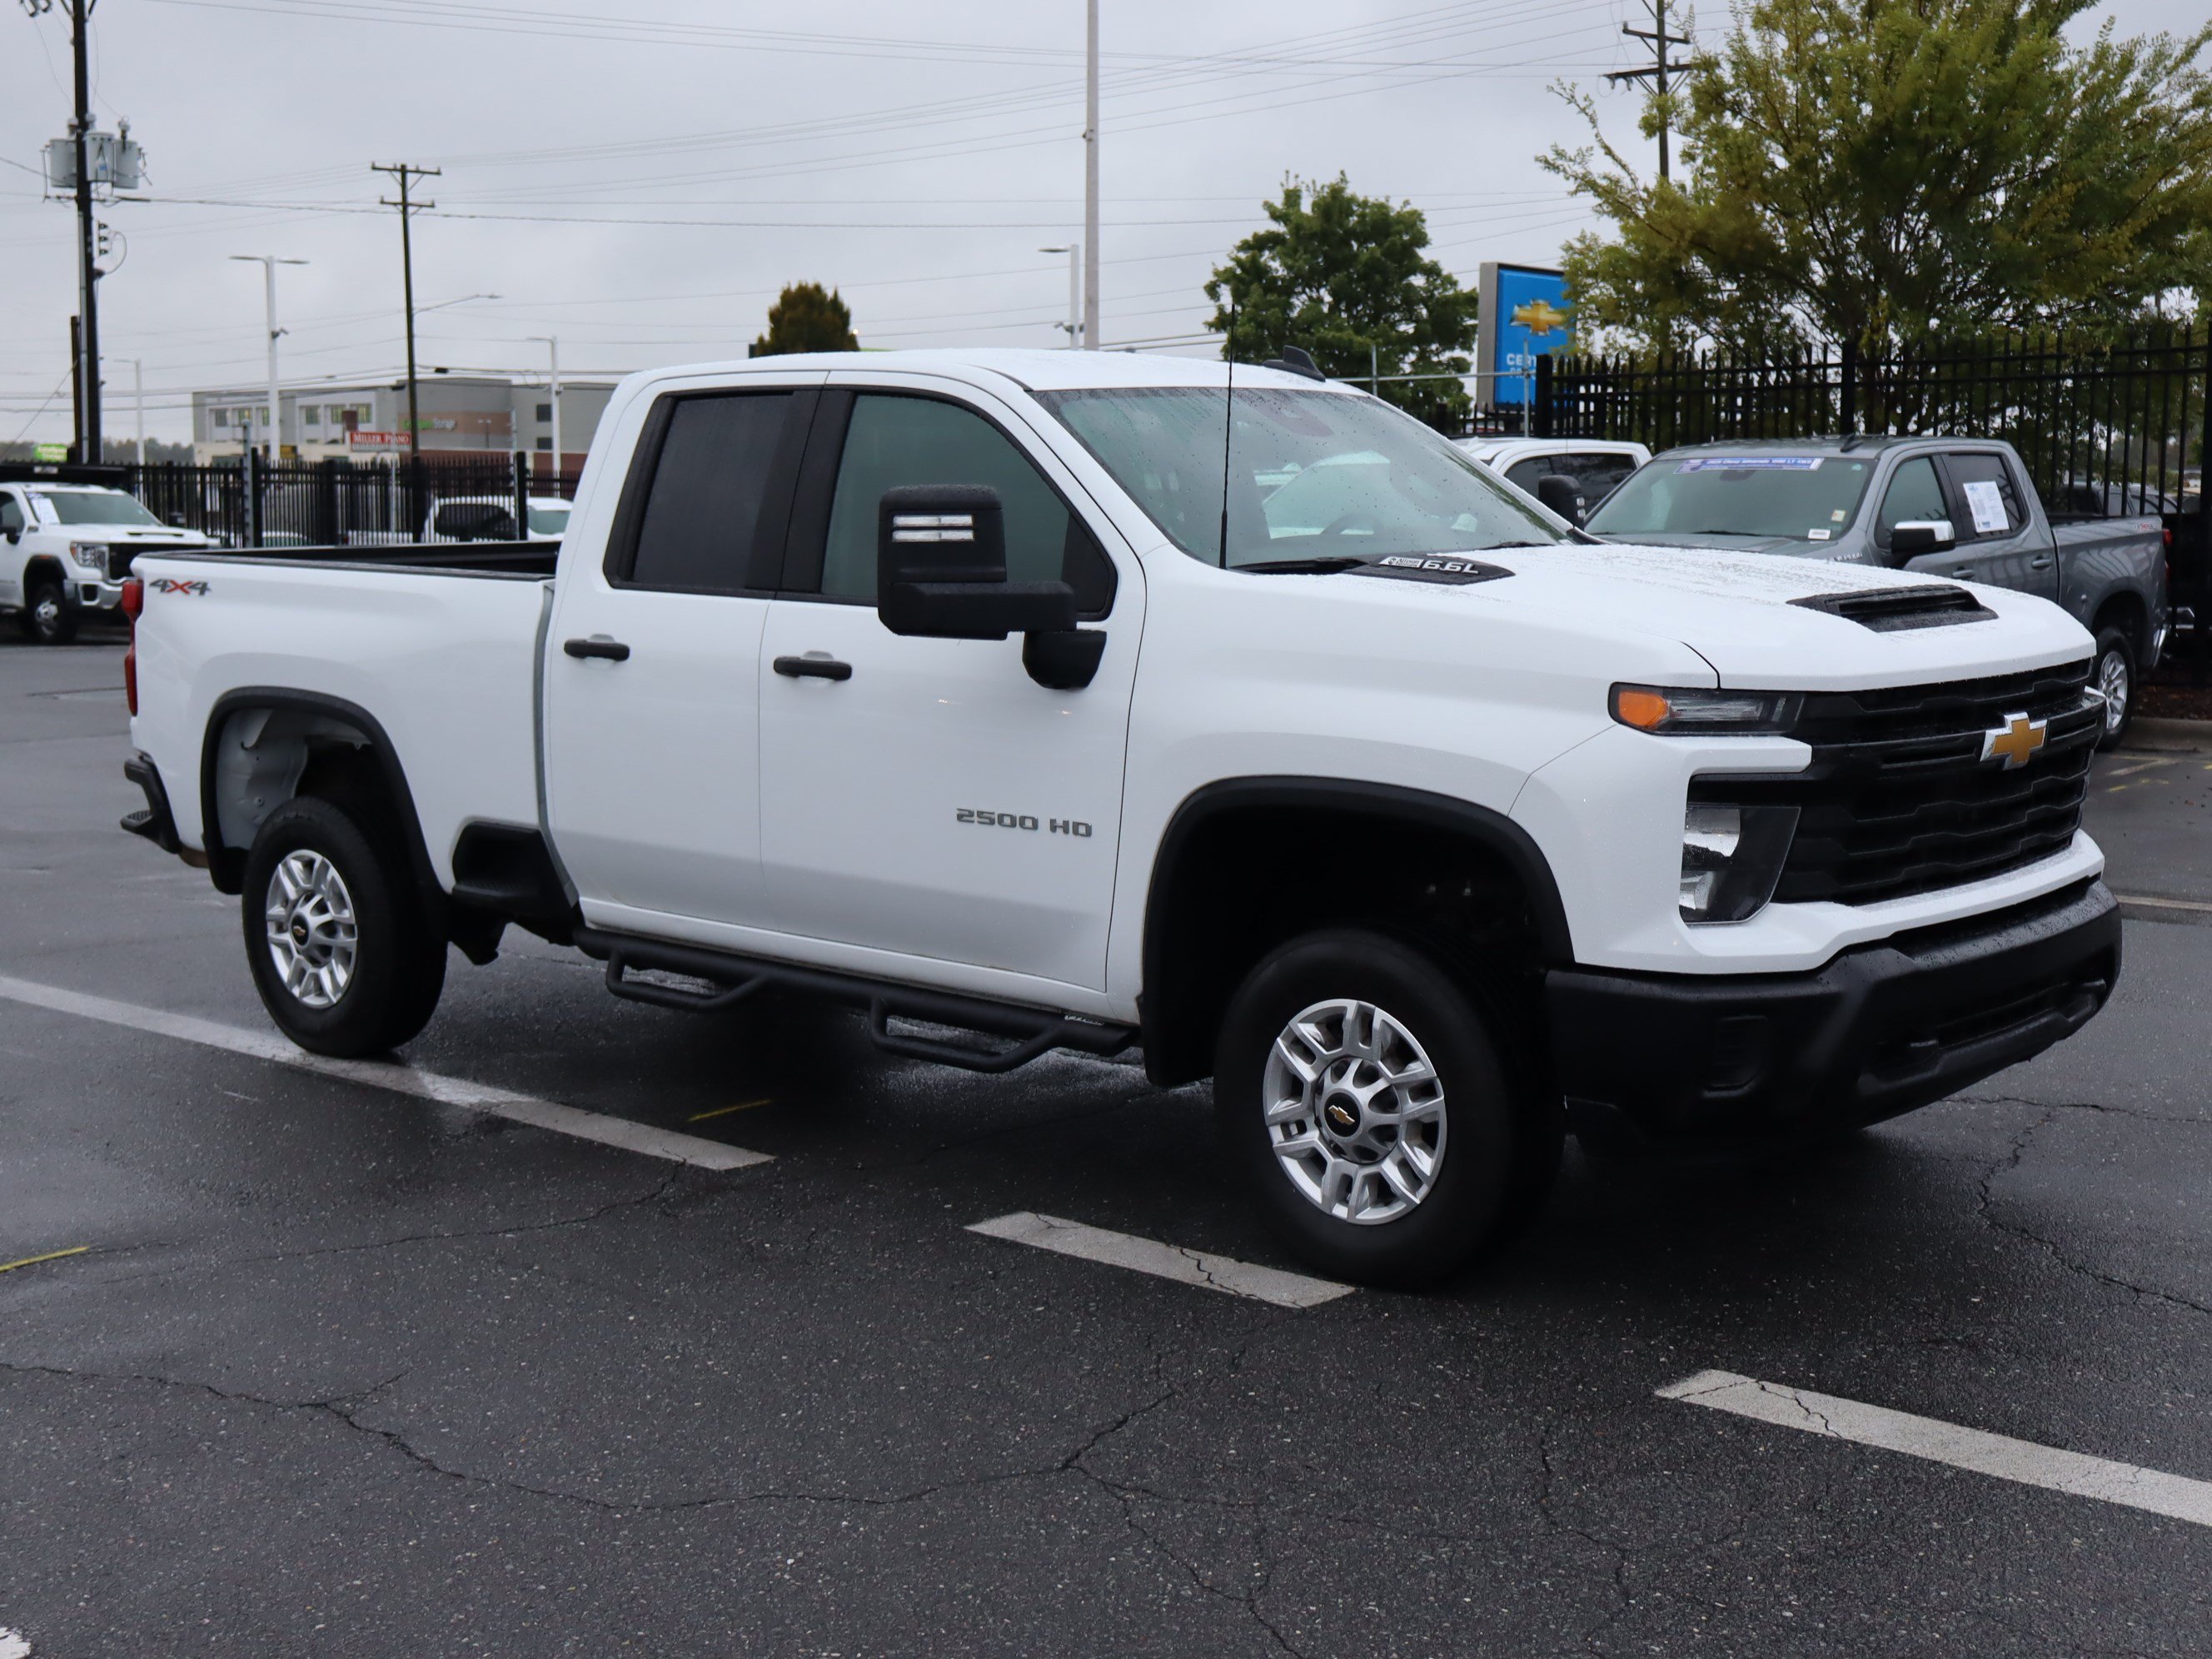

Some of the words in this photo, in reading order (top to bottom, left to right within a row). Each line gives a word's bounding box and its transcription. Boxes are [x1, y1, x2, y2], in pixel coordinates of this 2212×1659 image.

[1507, 353, 1537, 366] CERT
[353, 433, 381, 443] MILLER
[1422, 560, 1479, 574] 6.6L
[956, 808, 1039, 831] 2500
[1049, 818, 1093, 838] HD
